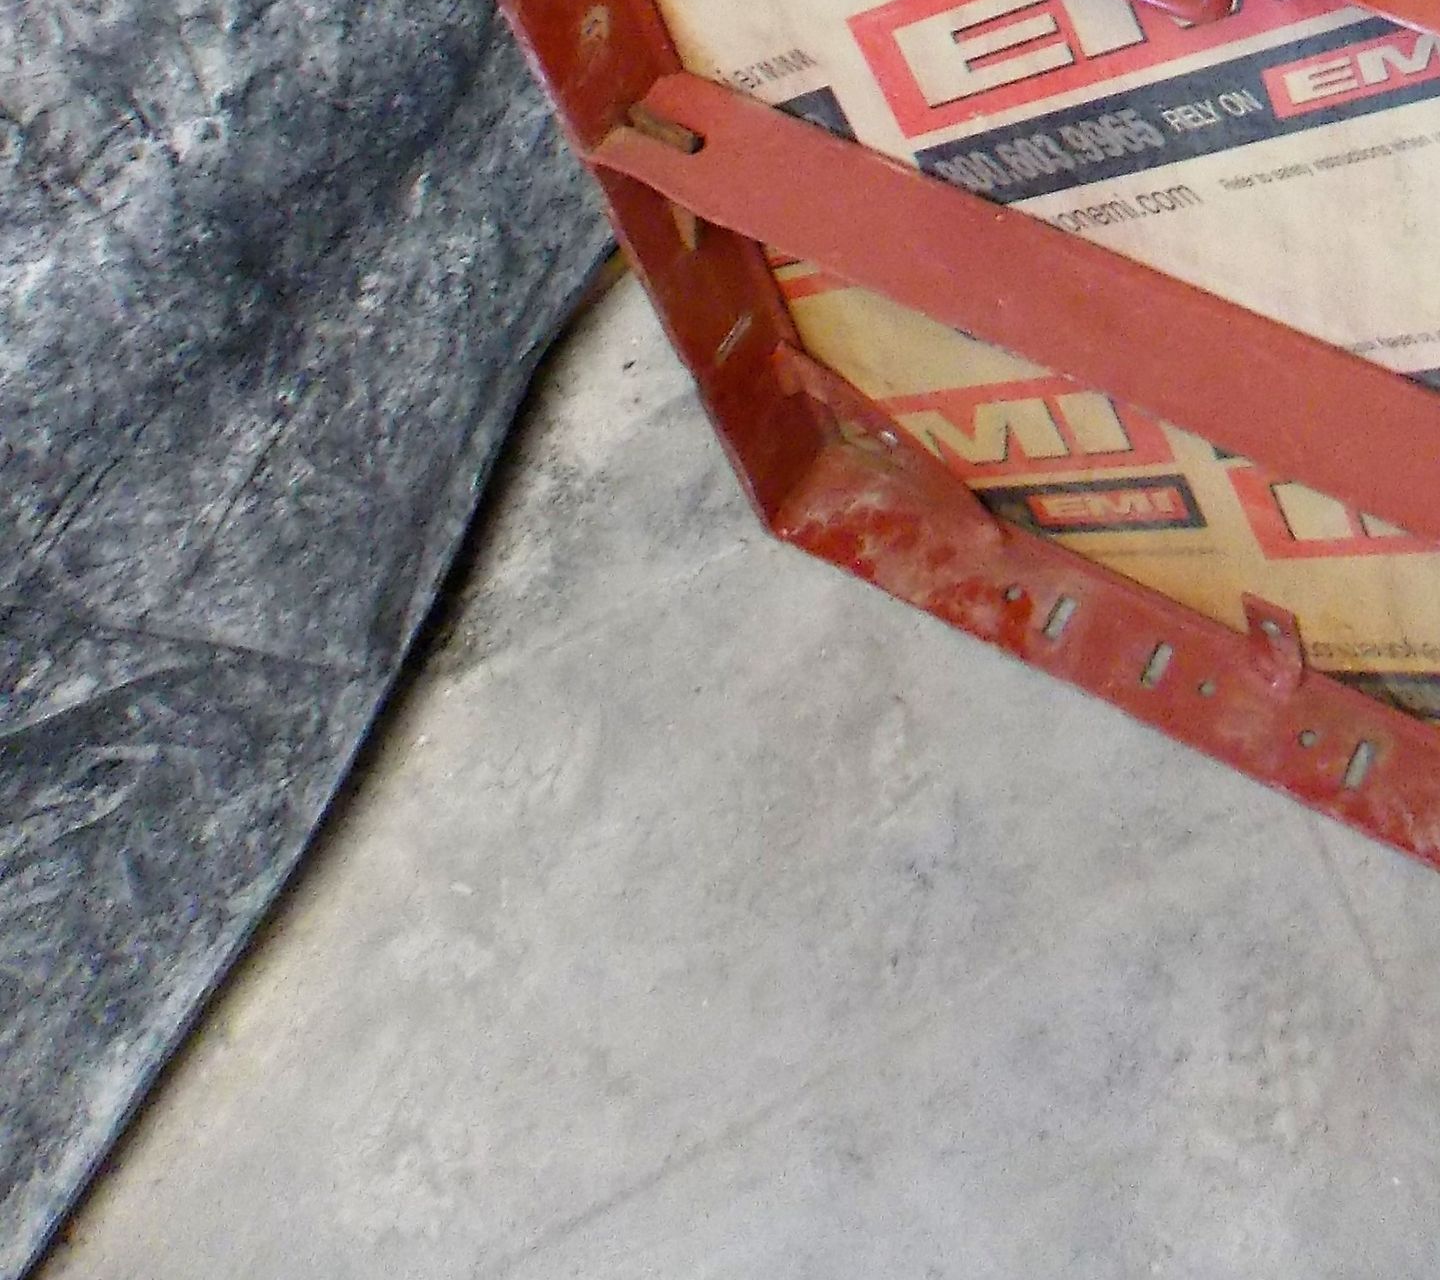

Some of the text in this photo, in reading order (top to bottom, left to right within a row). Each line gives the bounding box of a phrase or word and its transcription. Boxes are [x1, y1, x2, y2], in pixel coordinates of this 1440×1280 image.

[1160, 99, 1222, 134] RELY
[1219, 89, 1264, 119] ON
[1056, 184, 1204, 233] onemi.com
[895, 391, 1135, 466] MI
